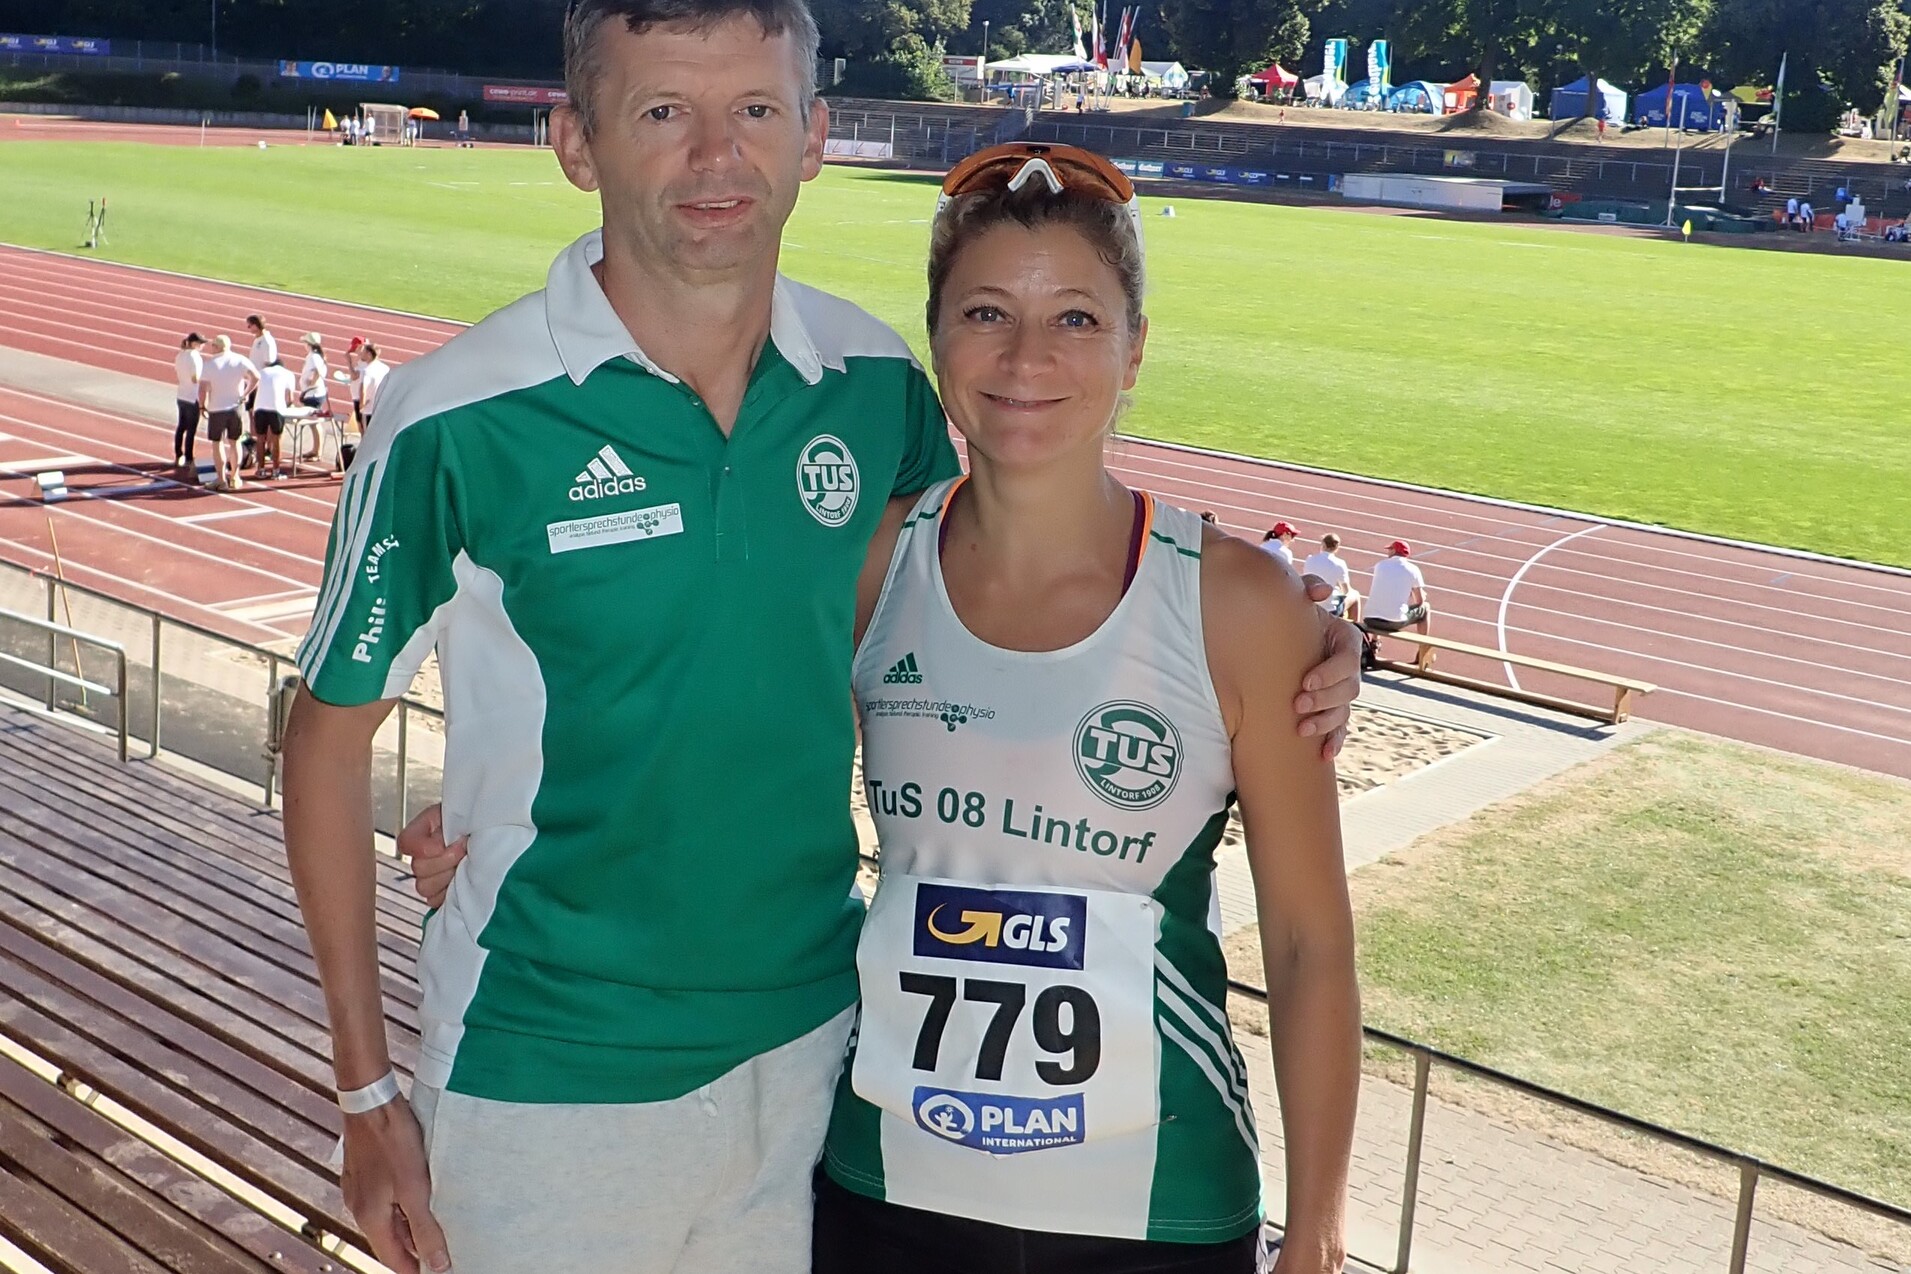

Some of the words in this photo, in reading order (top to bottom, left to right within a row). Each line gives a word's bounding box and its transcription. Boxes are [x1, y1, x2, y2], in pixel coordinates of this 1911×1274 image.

[336, 63, 368, 75] PLAN
[568, 475, 647, 502] adidas
[803, 465, 853, 491] TUS
[549, 510, 644, 537] sportlersprechstunde
[650, 505, 679, 523] physio
[883, 671, 923, 684] adidas
[958, 703, 996, 720] physio
[1090, 728, 1174, 776] TUS
[1099, 778, 1140, 800] LINTORF
[1141, 784, 1161, 799] 1908
[868, 780, 923, 819] TuS
[937, 787, 986, 828] 08
[1002, 798, 1157, 864] Lintorf
[1002, 914, 1071, 953] GLS
[898, 971, 1102, 1087] 779
[981, 1106, 1076, 1135] PLAN
[982, 1136, 1077, 1147] INTERNATIONAL
